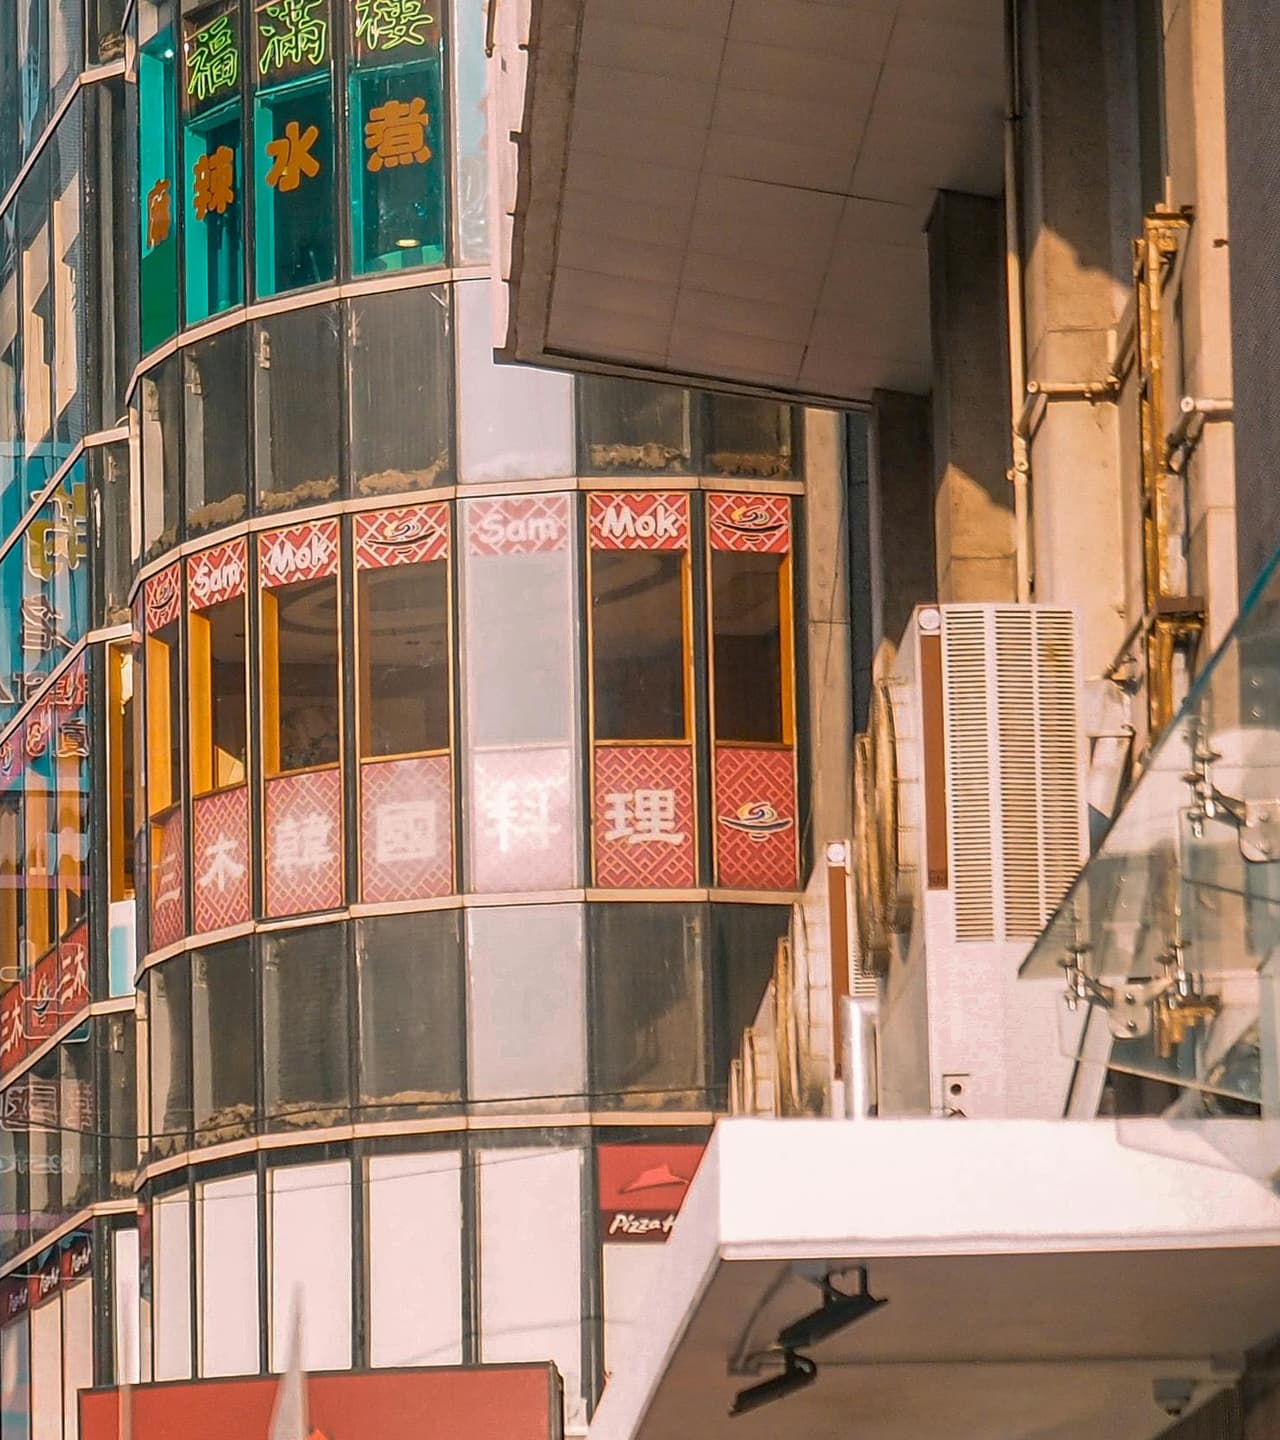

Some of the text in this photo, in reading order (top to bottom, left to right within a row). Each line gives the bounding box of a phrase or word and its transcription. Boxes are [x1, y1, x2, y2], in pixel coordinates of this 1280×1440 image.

[146, 97, 432, 249] 麻辣水煮
[480, 505, 678, 544] Sam Mok
[194, 534, 328, 596] Sam Mok
[609, 1213, 661, 1234] Pizza
